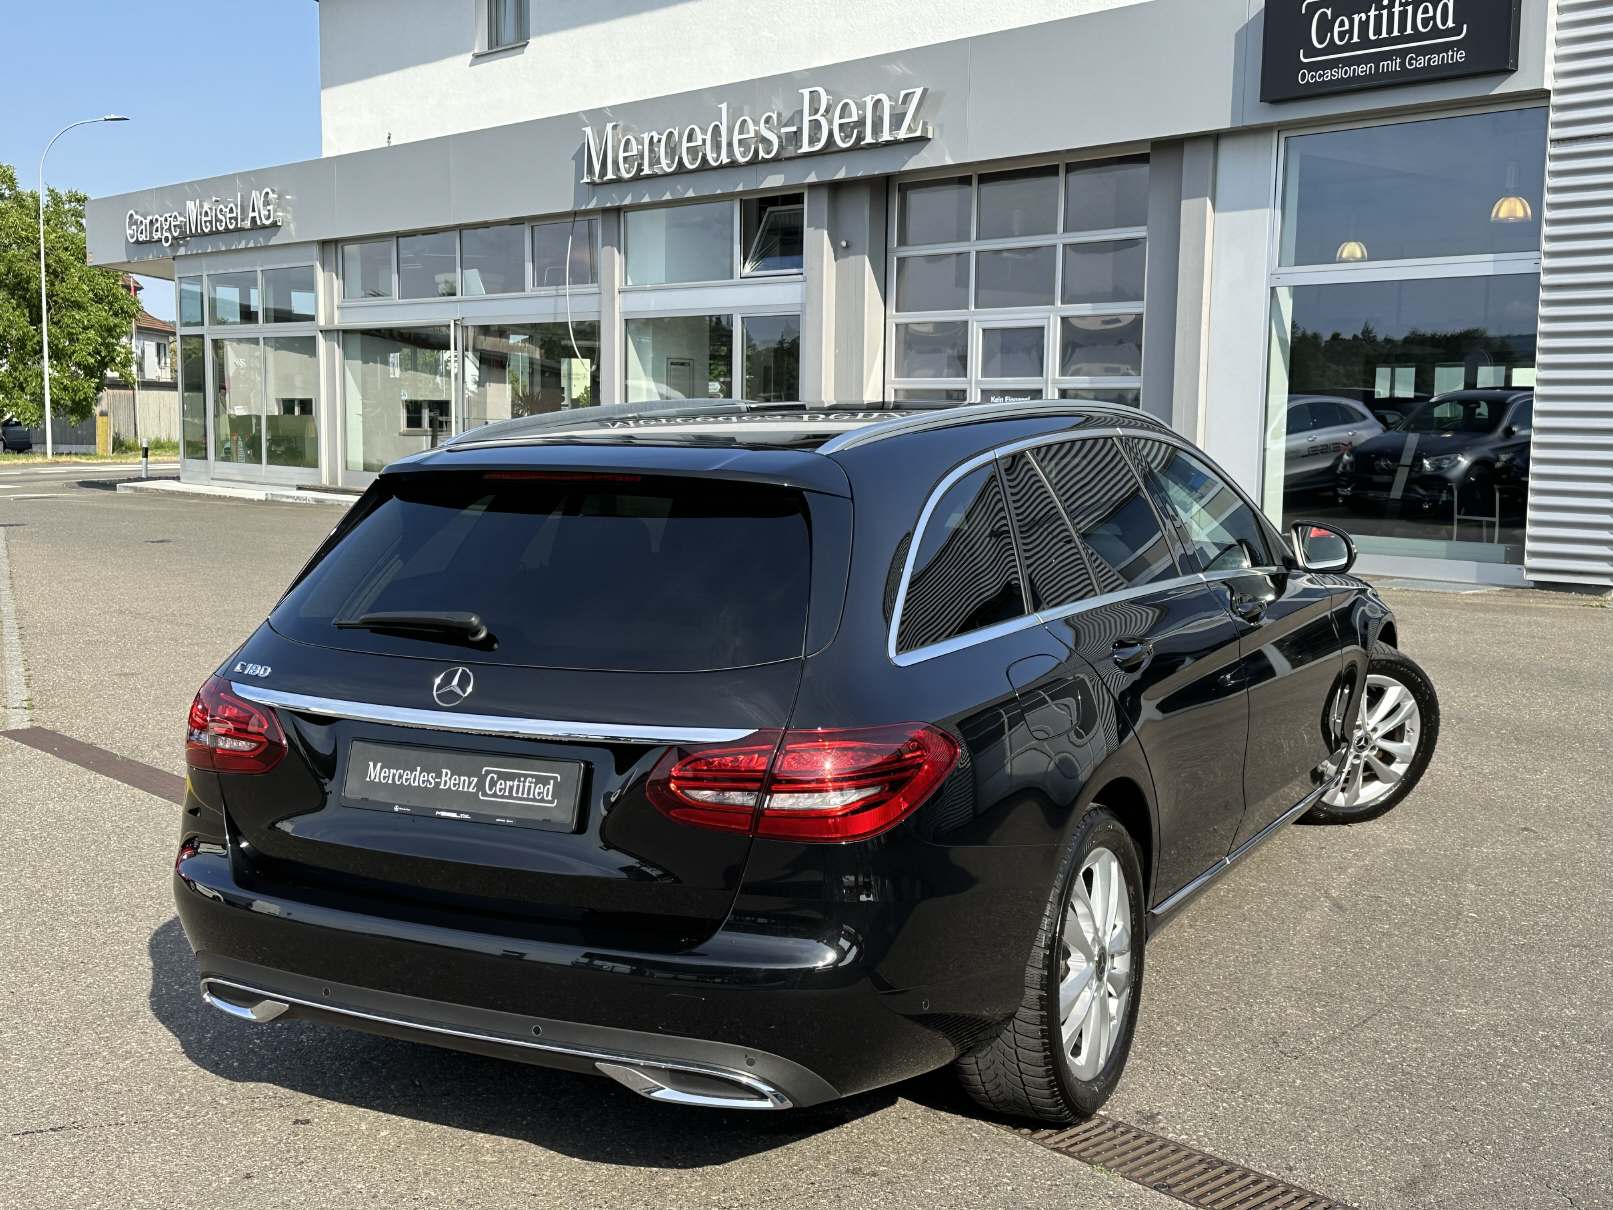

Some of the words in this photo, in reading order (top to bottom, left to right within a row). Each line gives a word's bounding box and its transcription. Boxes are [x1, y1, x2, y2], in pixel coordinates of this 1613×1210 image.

[1309, 0, 1457, 49] Certified
[1298, 62, 1375, 85] Occasionen
[1379, 56, 1401, 74] mit
[1405, 47, 1466, 70] Garantie
[580, 85, 930, 184] Mercedes-Benz
[126, 209, 181, 247] Garage
[186, 191, 241, 235] Meisel
[366, 761, 477, 793] Mercedes-Benz
[484, 773, 554, 801] Certified
